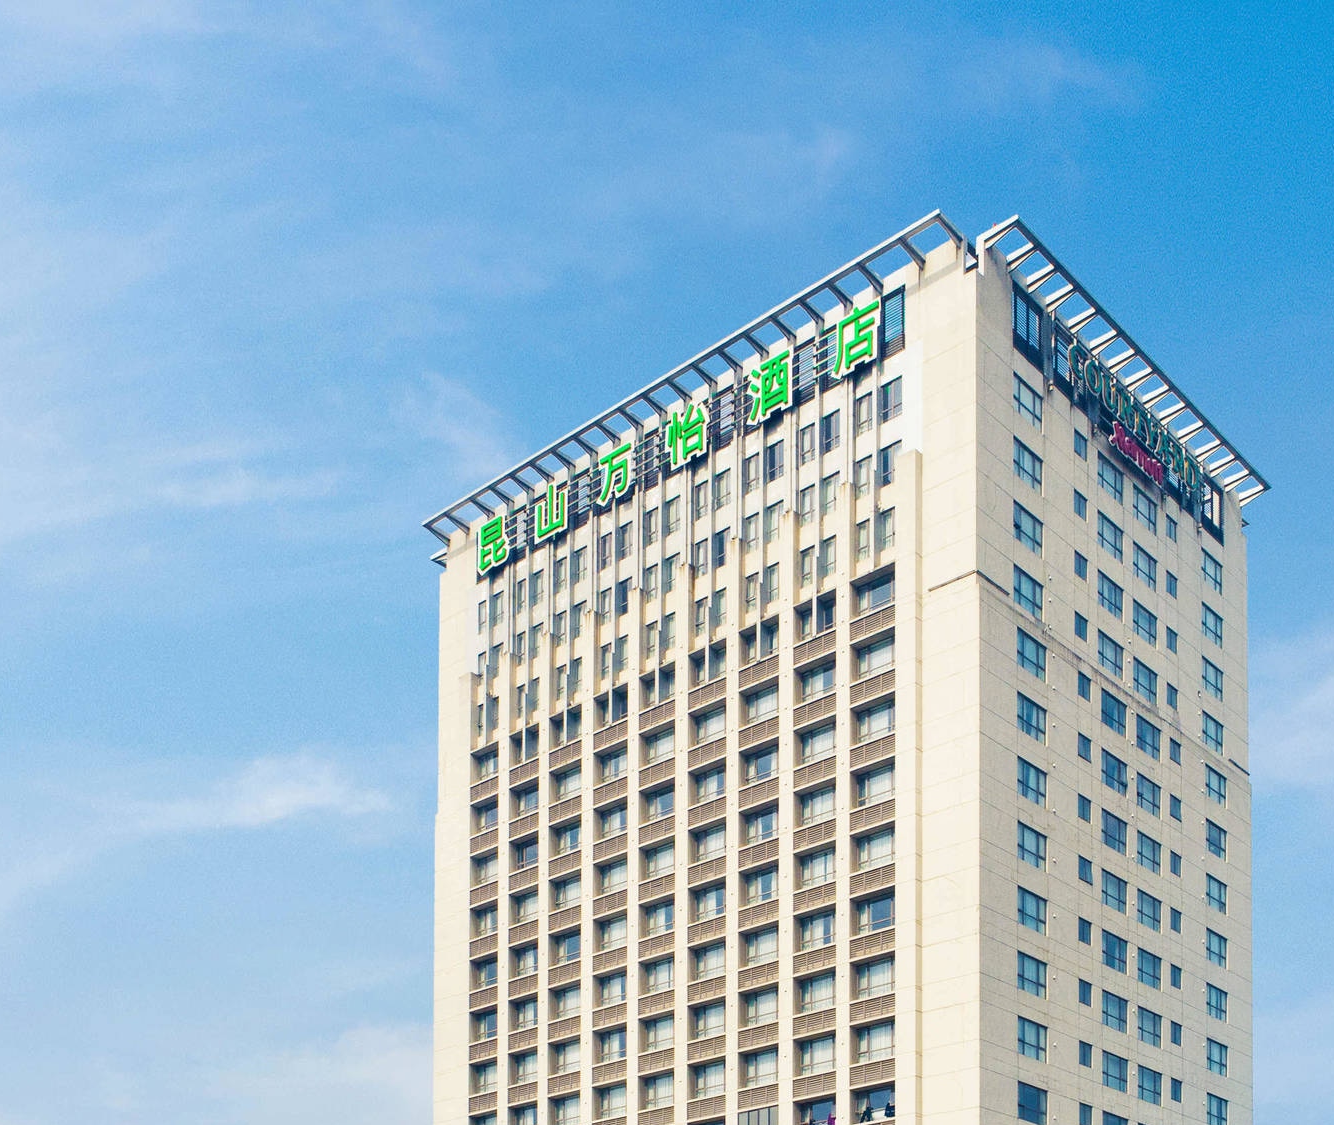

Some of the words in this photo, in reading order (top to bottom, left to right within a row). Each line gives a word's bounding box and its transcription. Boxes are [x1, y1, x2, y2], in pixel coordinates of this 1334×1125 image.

[478, 299, 881, 576] 昆山万怡酒店
[1068, 344, 1201, 491] COURTYARD
